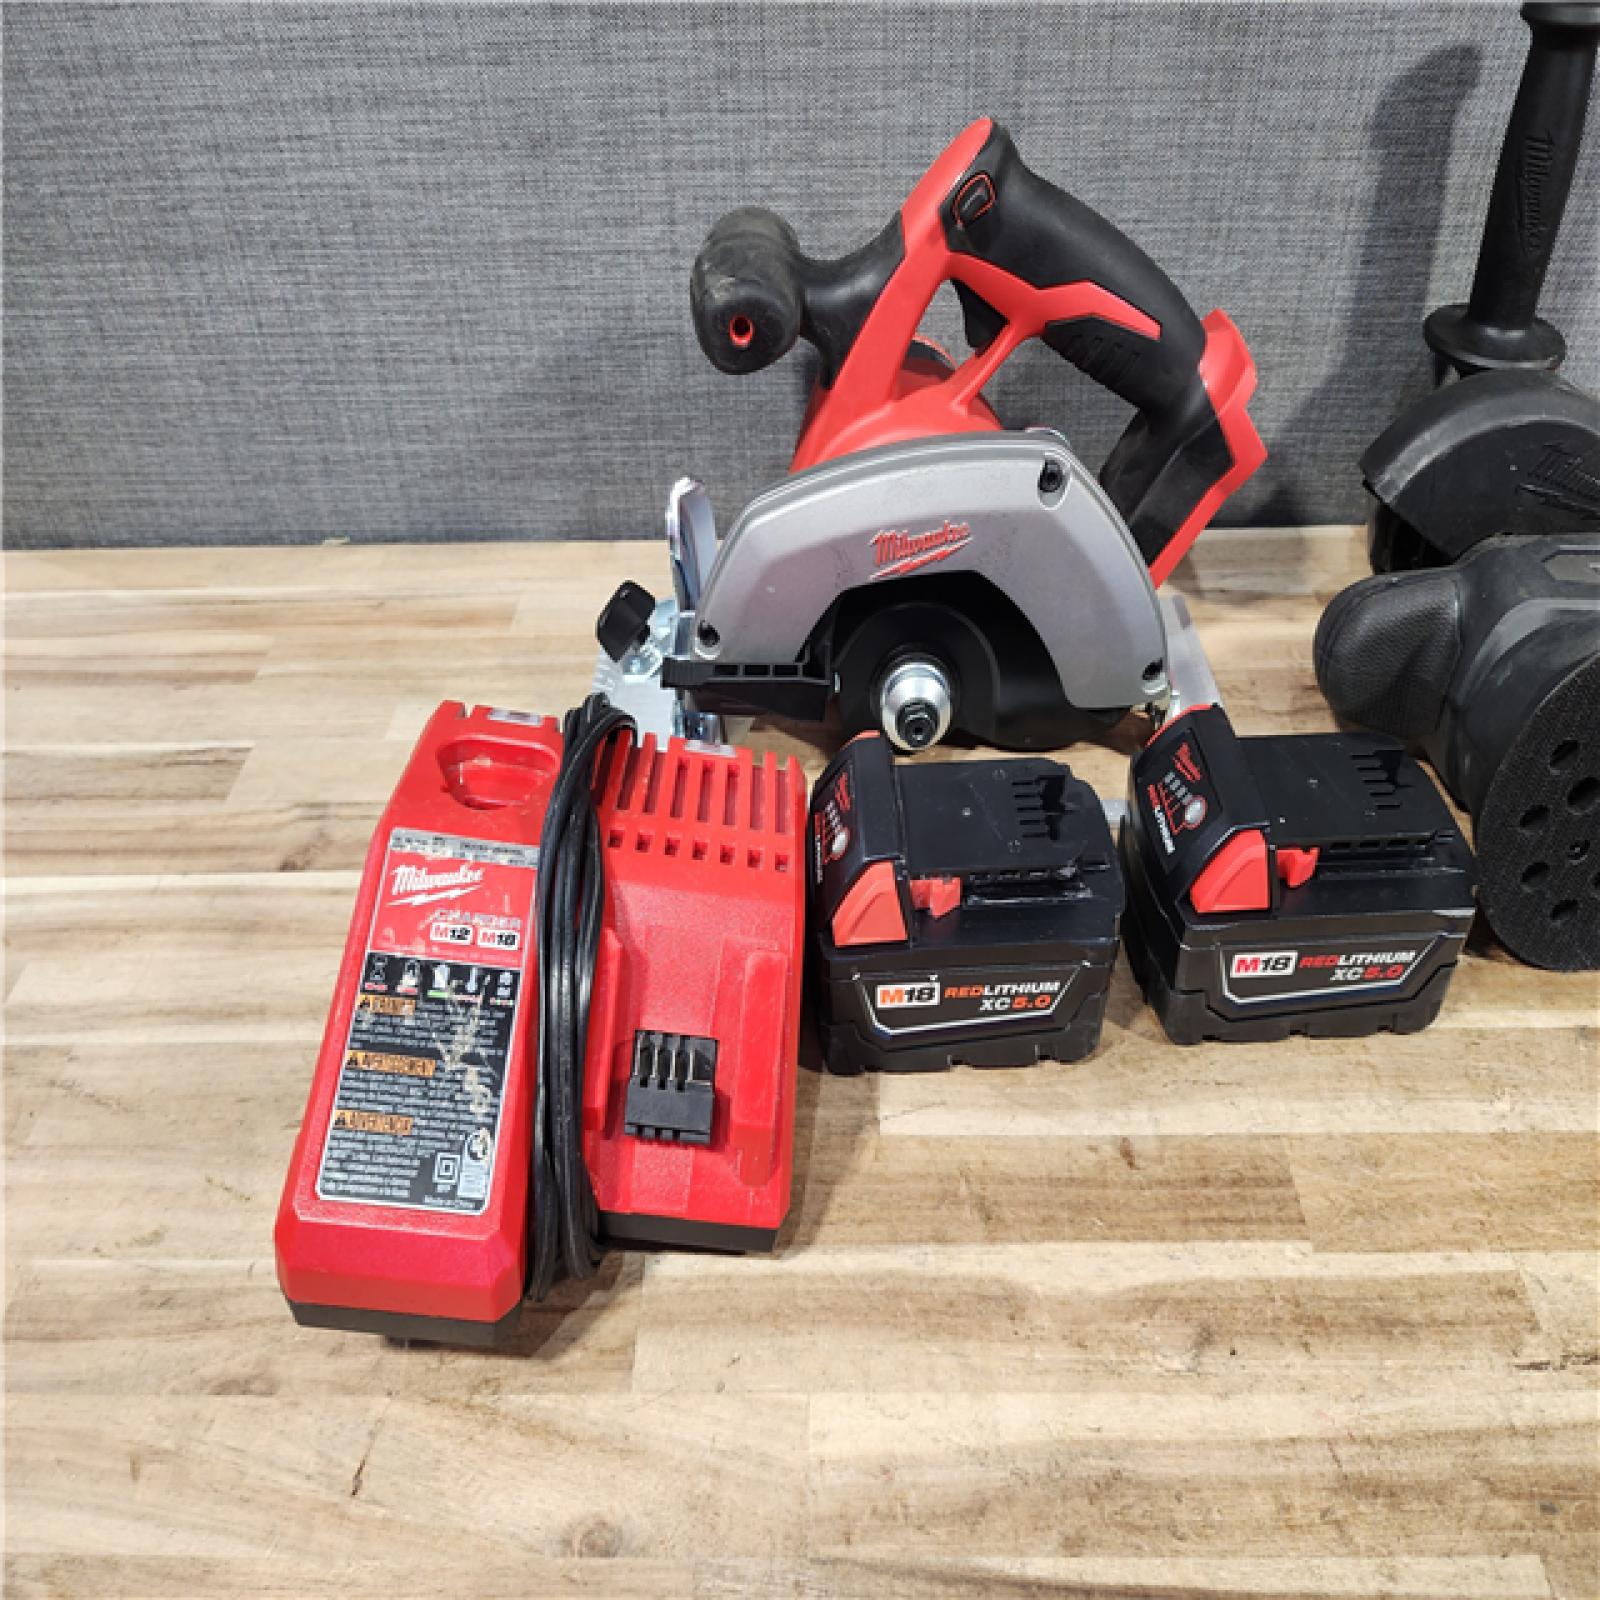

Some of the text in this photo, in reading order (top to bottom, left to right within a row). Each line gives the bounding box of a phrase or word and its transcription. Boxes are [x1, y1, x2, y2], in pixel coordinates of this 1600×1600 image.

[869, 520, 970, 568] Milwaukee
[390, 864, 486, 897] Milwaukee
[433, 924, 471, 943] M12
[1233, 952, 1416, 976] M18 REDLITHIUM
[878, 980, 1060, 1006] M18 REDLITHIUM
